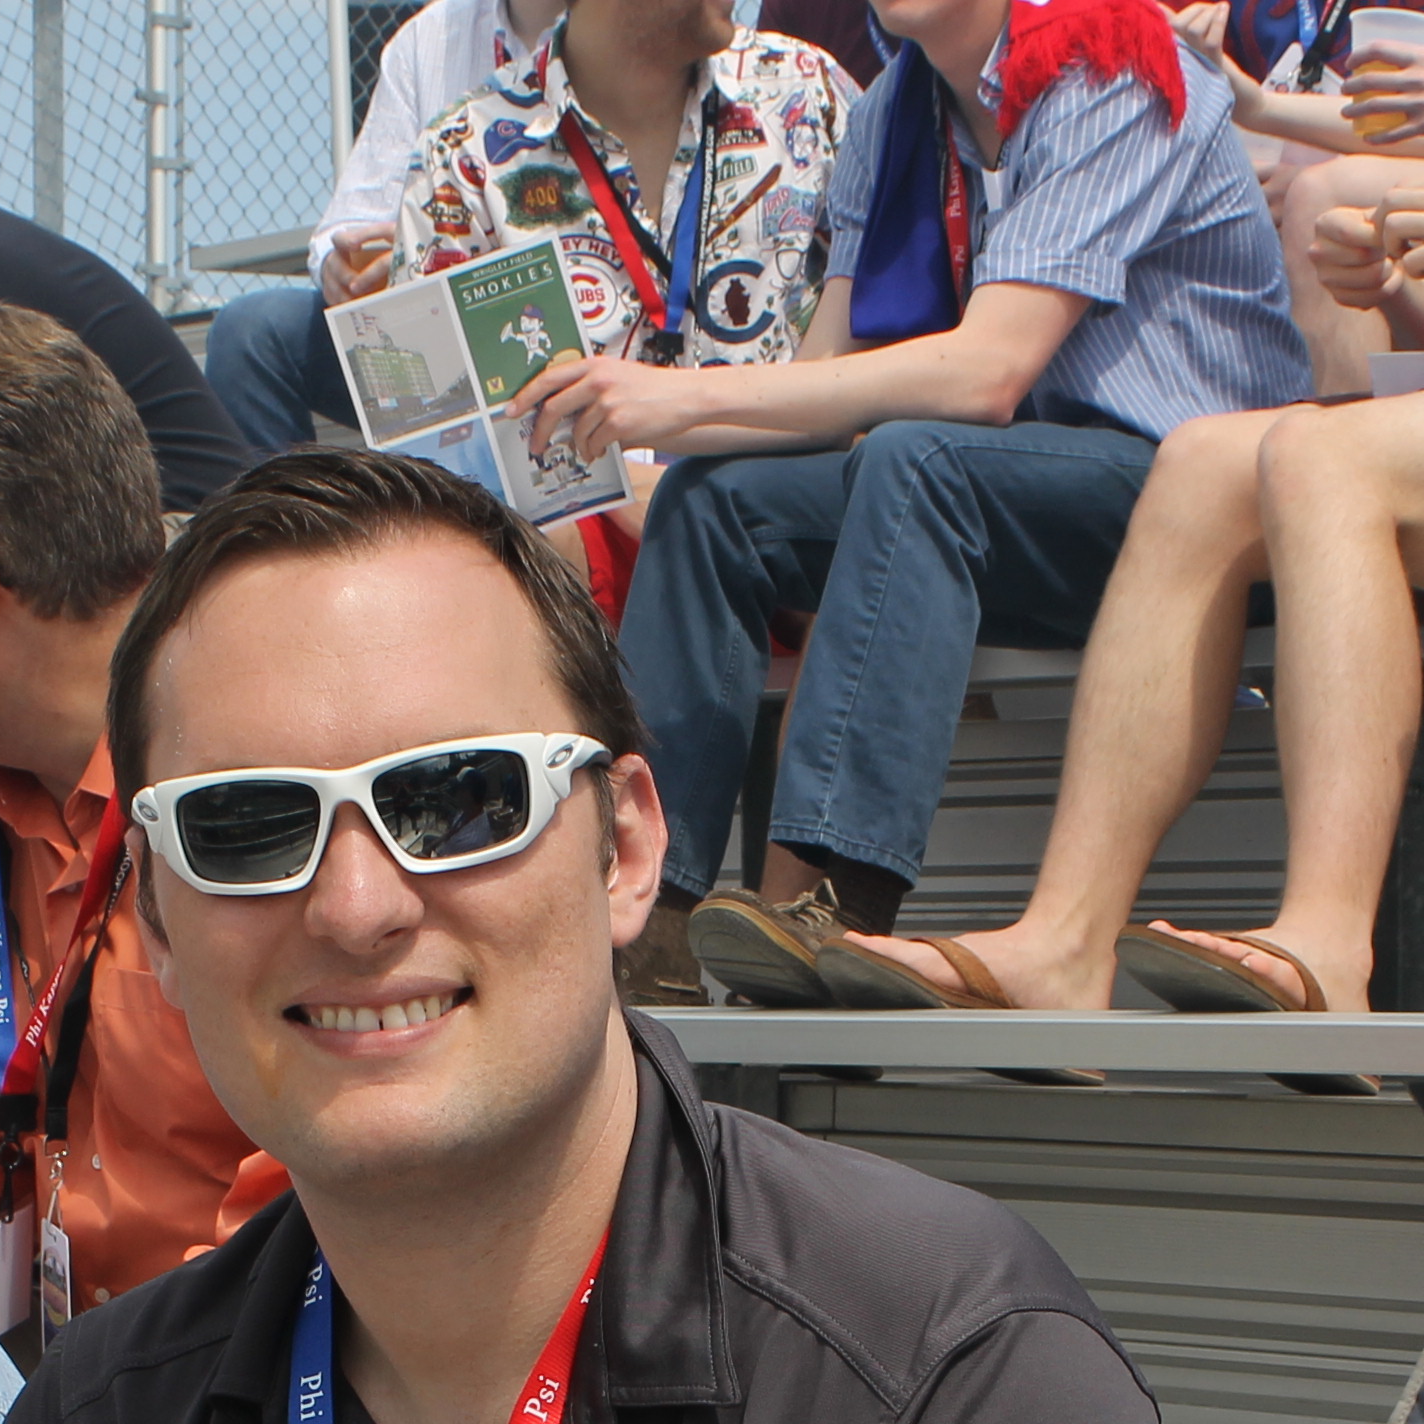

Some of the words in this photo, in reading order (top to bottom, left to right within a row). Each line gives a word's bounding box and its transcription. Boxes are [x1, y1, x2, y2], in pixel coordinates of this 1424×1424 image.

[463, 262, 553, 304] SMOKIES
[472, 260, 509, 279] WRIGLEY
[25, 1016, 44, 1047] Phi
[304, 1263, 323, 1308] Psi
[300, 1371, 324, 1421] Phi
[523, 1375, 560, 1423] Psi
